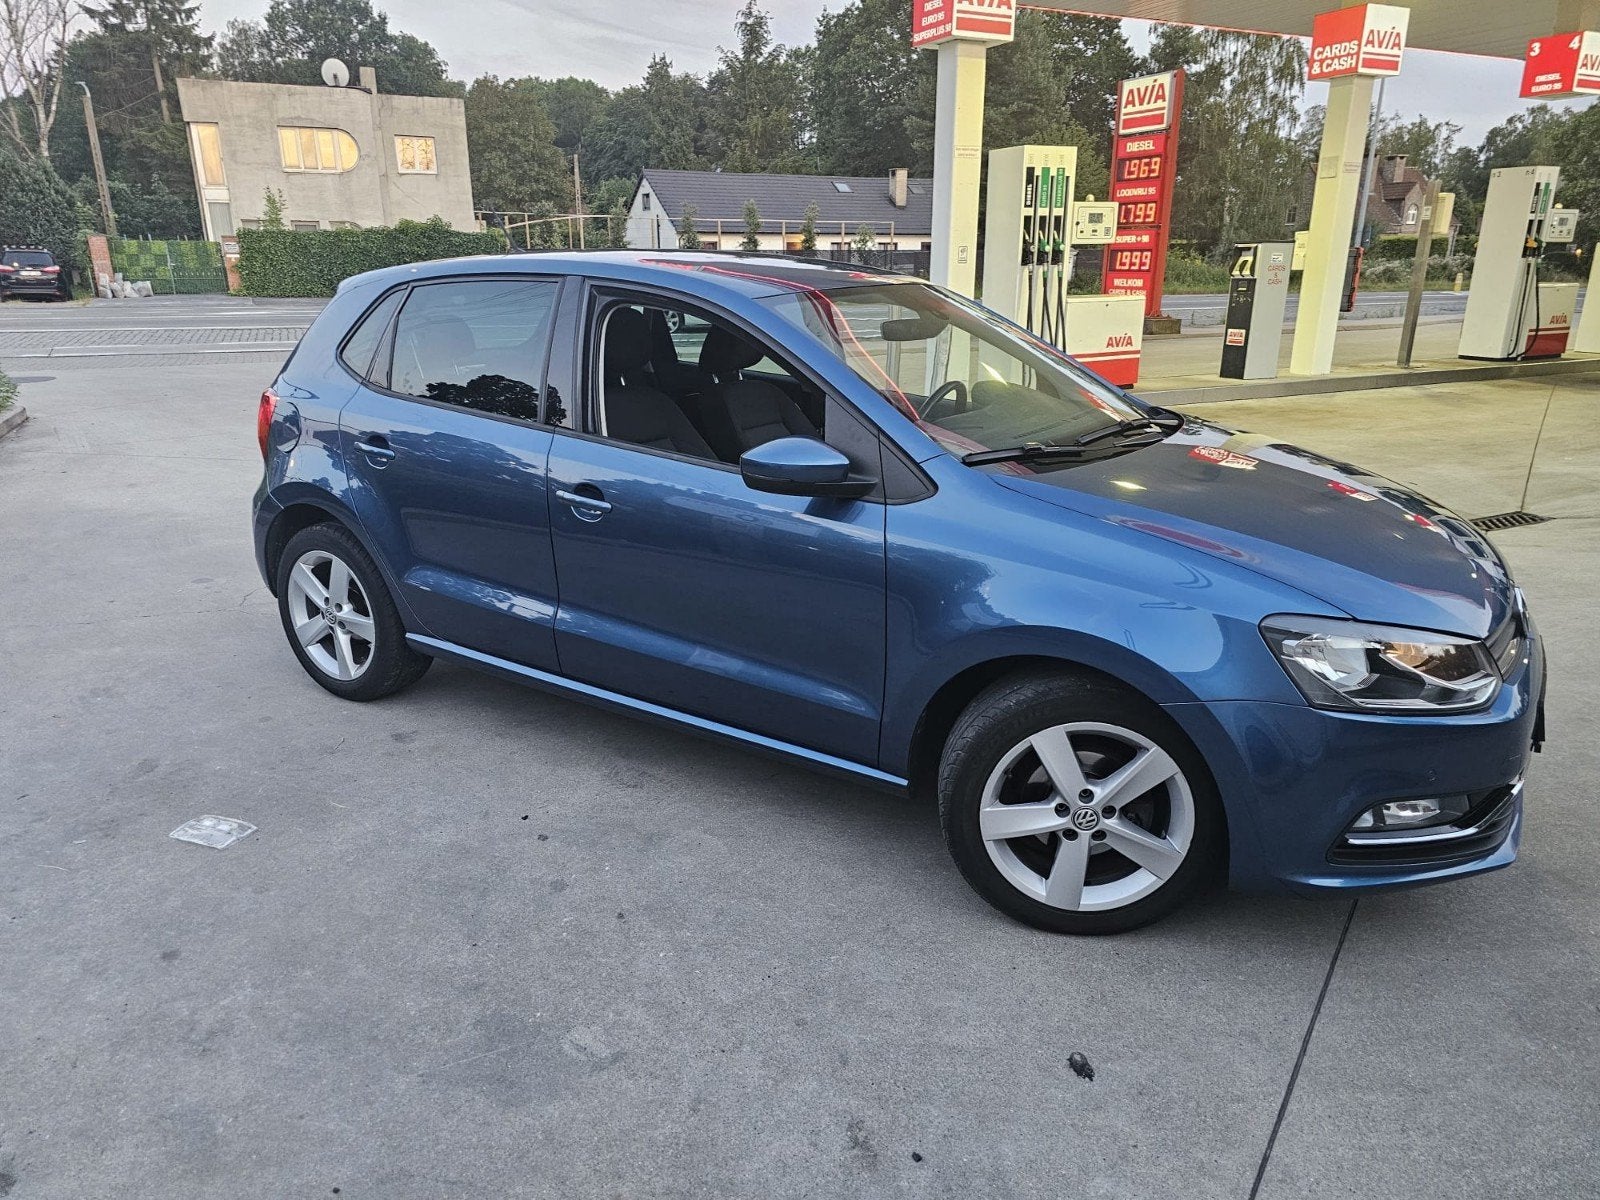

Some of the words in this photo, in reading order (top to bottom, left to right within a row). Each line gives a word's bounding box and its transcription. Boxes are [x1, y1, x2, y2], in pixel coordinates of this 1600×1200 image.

[923, 0, 944, 11] DIESEL
[922, 13, 937, 26] EURO
[937, 11, 945, 20] 95
[1314, 40, 1359, 60] CARDS
[1529, 42, 1541, 56] 3
[1568, 34, 1581, 50] 4
[1311, 61, 1321, 75] &
[1322, 55, 1357, 73] CASH
[1126, 140, 1156, 153] DIESEL
[1148, 186, 1156, 195] 95
[1113, 278, 1143, 287] WELKOM
